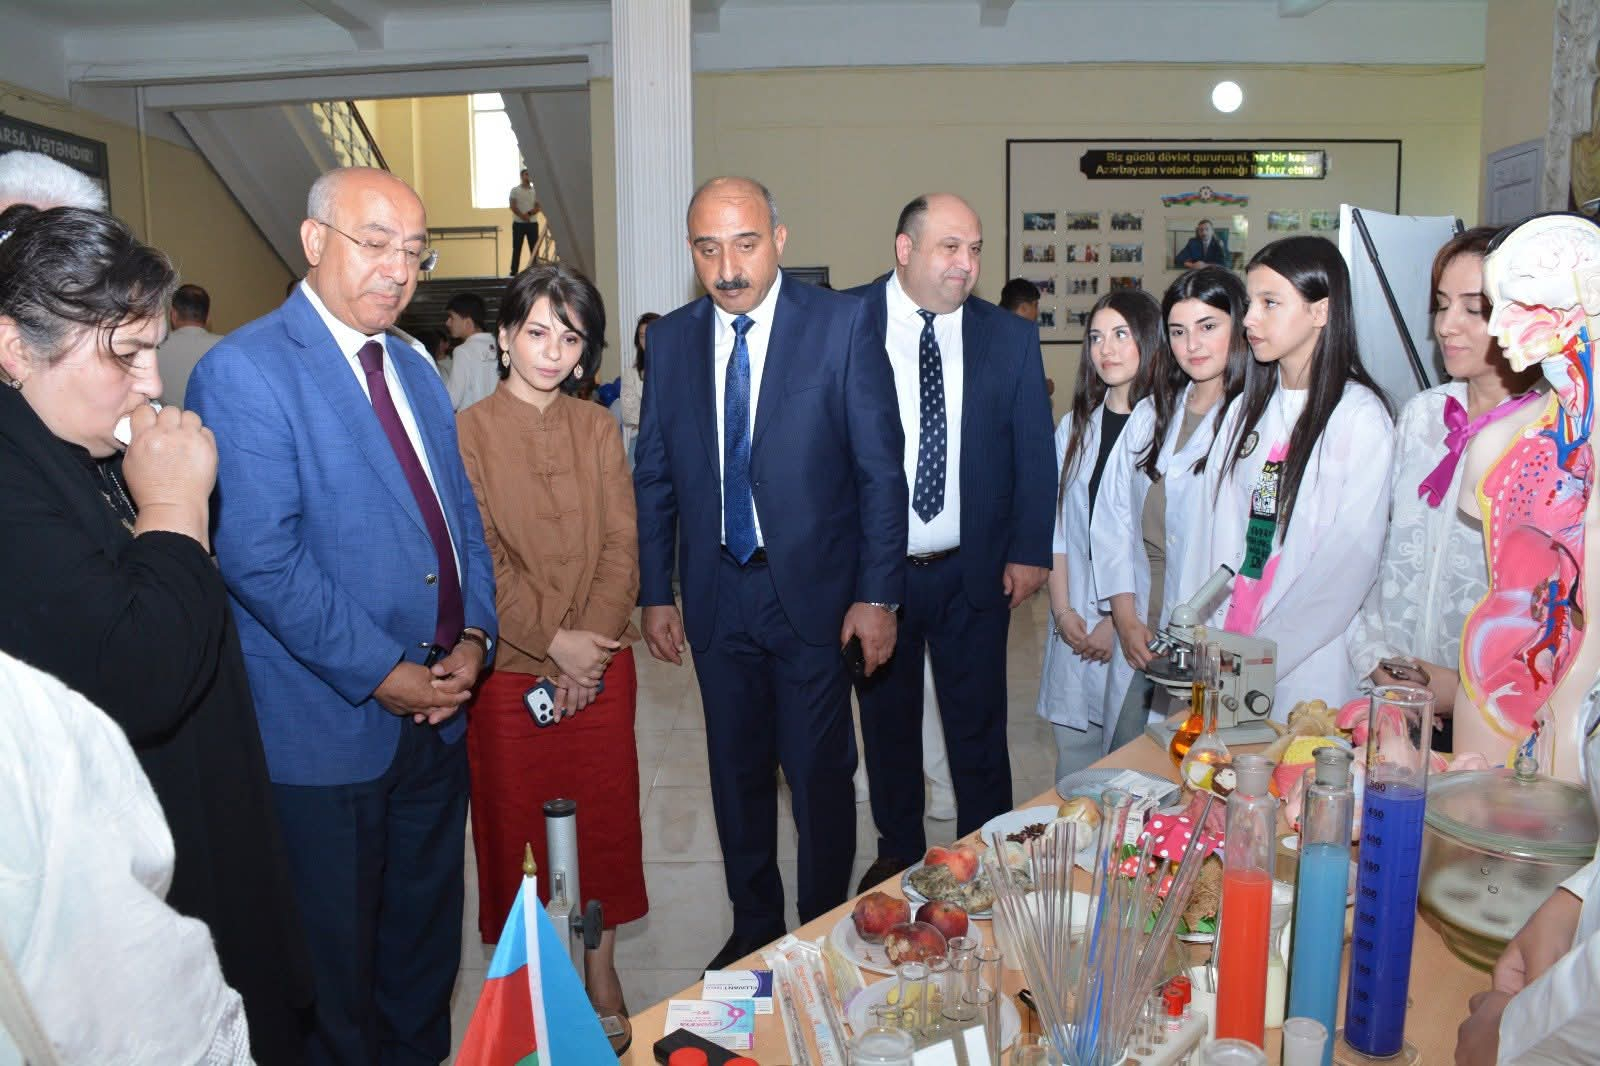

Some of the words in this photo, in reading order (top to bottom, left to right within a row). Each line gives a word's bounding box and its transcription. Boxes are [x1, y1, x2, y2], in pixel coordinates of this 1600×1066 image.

[1106, 152, 1123, 162] Biz
[1271, 152, 1286, 162] bir
[1369, 780, 1386, 792] 500
[1367, 807, 1384, 820] 450
